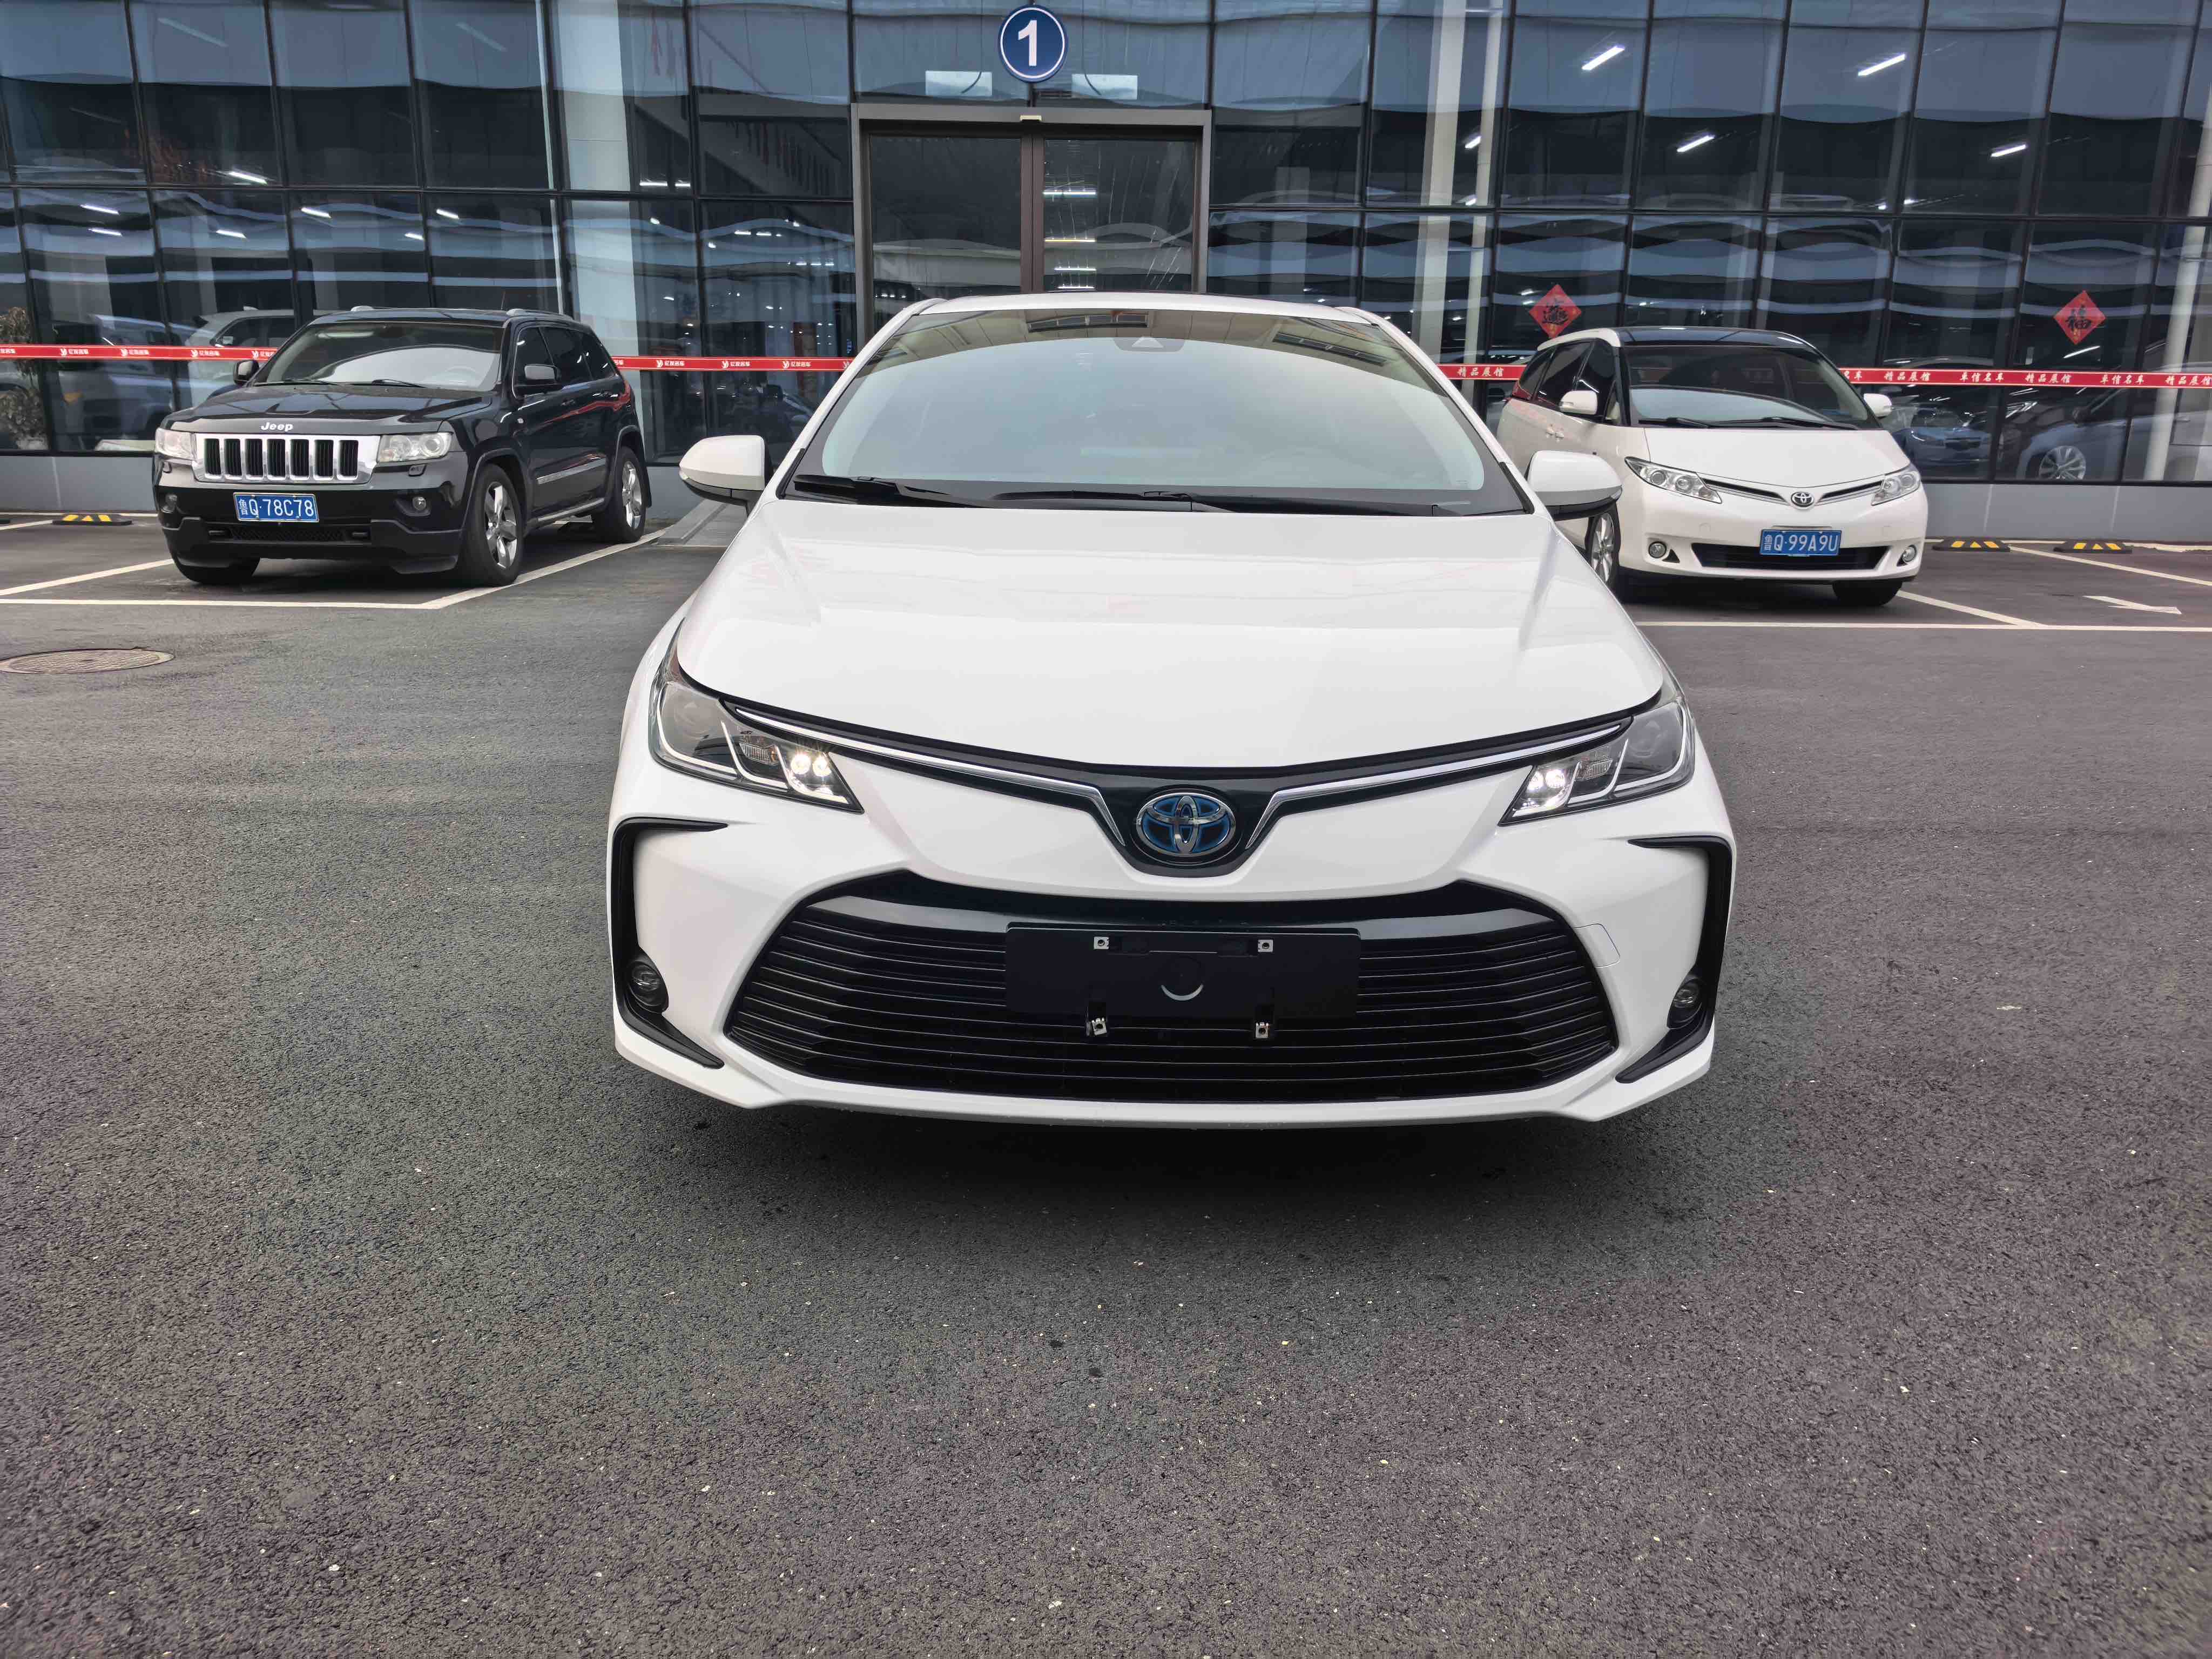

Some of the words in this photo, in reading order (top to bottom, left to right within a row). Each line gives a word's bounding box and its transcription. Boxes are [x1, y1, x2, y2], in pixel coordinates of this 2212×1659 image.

[1017, 20, 1037, 66] 1
[1457, 366, 1504, 377] 精品展馆
[1884, 371, 1931, 381] 精品展馆
[2025, 373, 2072, 384] 精品展馆
[261, 422, 293, 432] Jeep
